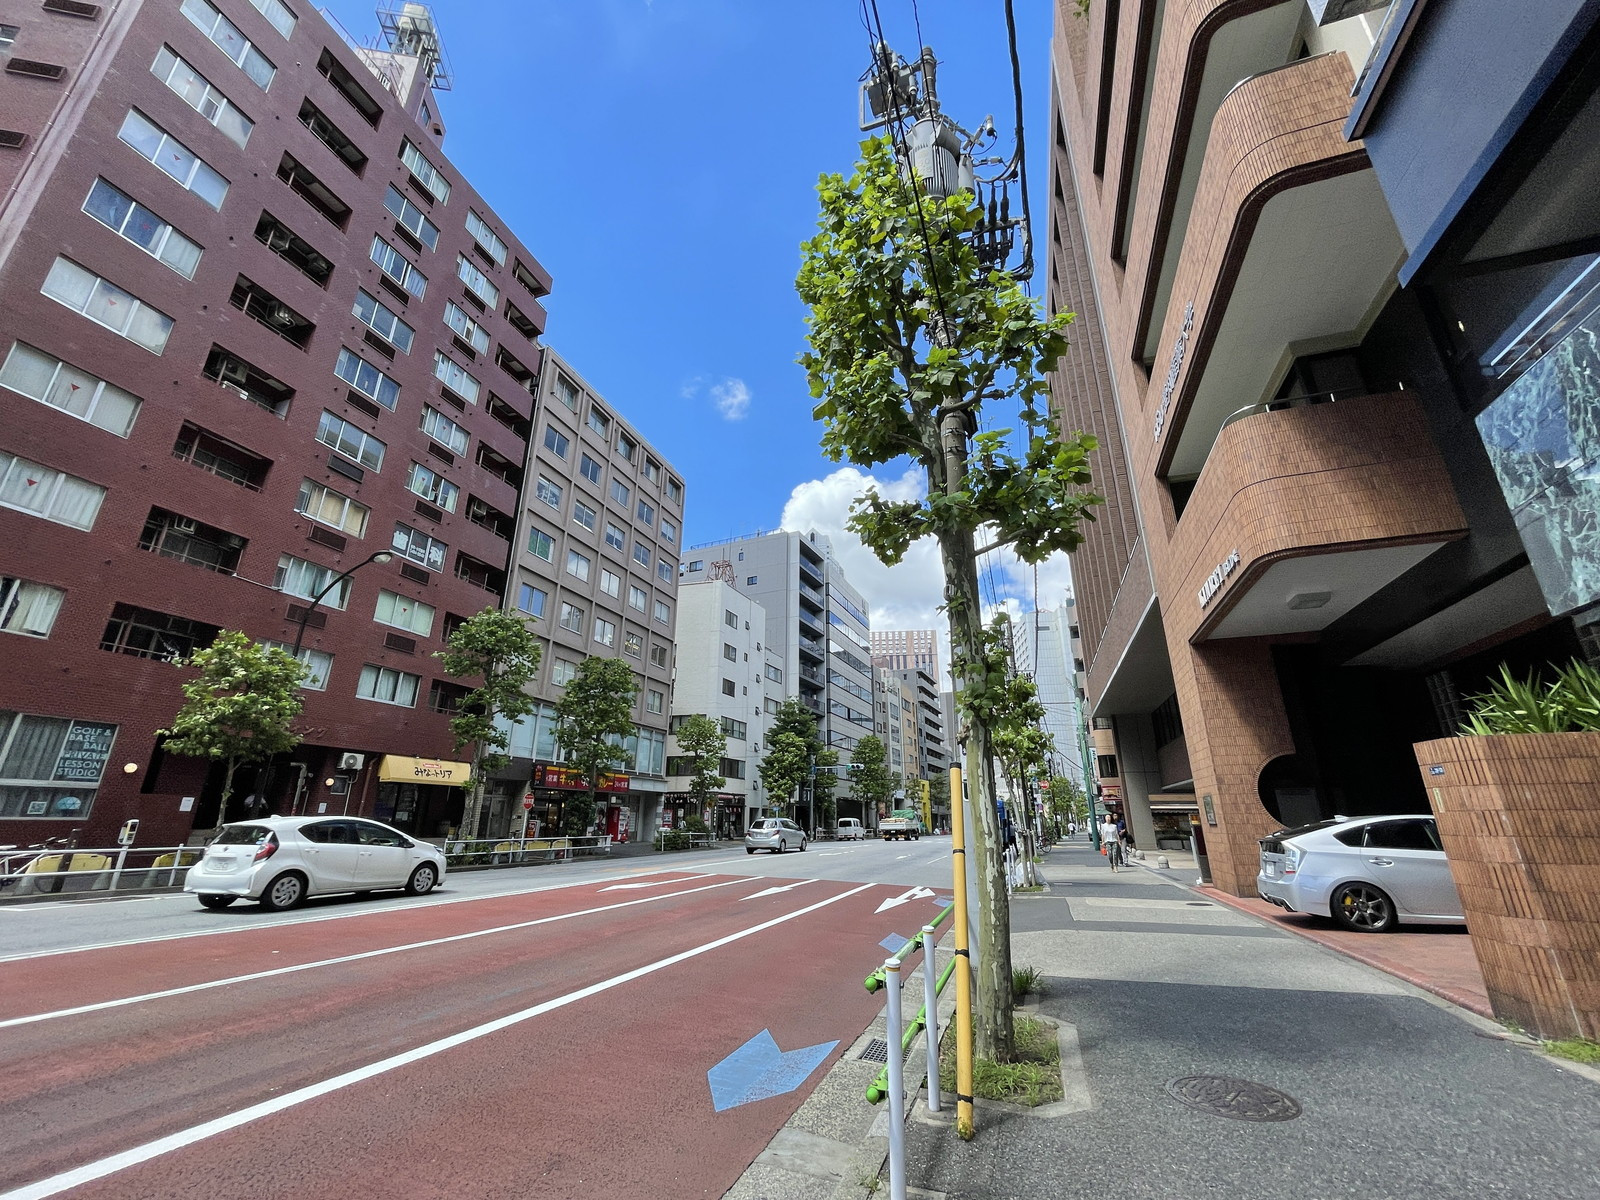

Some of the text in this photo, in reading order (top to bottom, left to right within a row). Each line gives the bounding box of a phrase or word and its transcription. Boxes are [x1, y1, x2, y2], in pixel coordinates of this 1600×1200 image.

[72, 727, 102, 735] GOLF
[69, 734, 97, 742] BASE
[83, 742, 107, 750] BALL
[59, 760, 101, 768] LESSON
[57, 768, 97, 776] STUDIO
